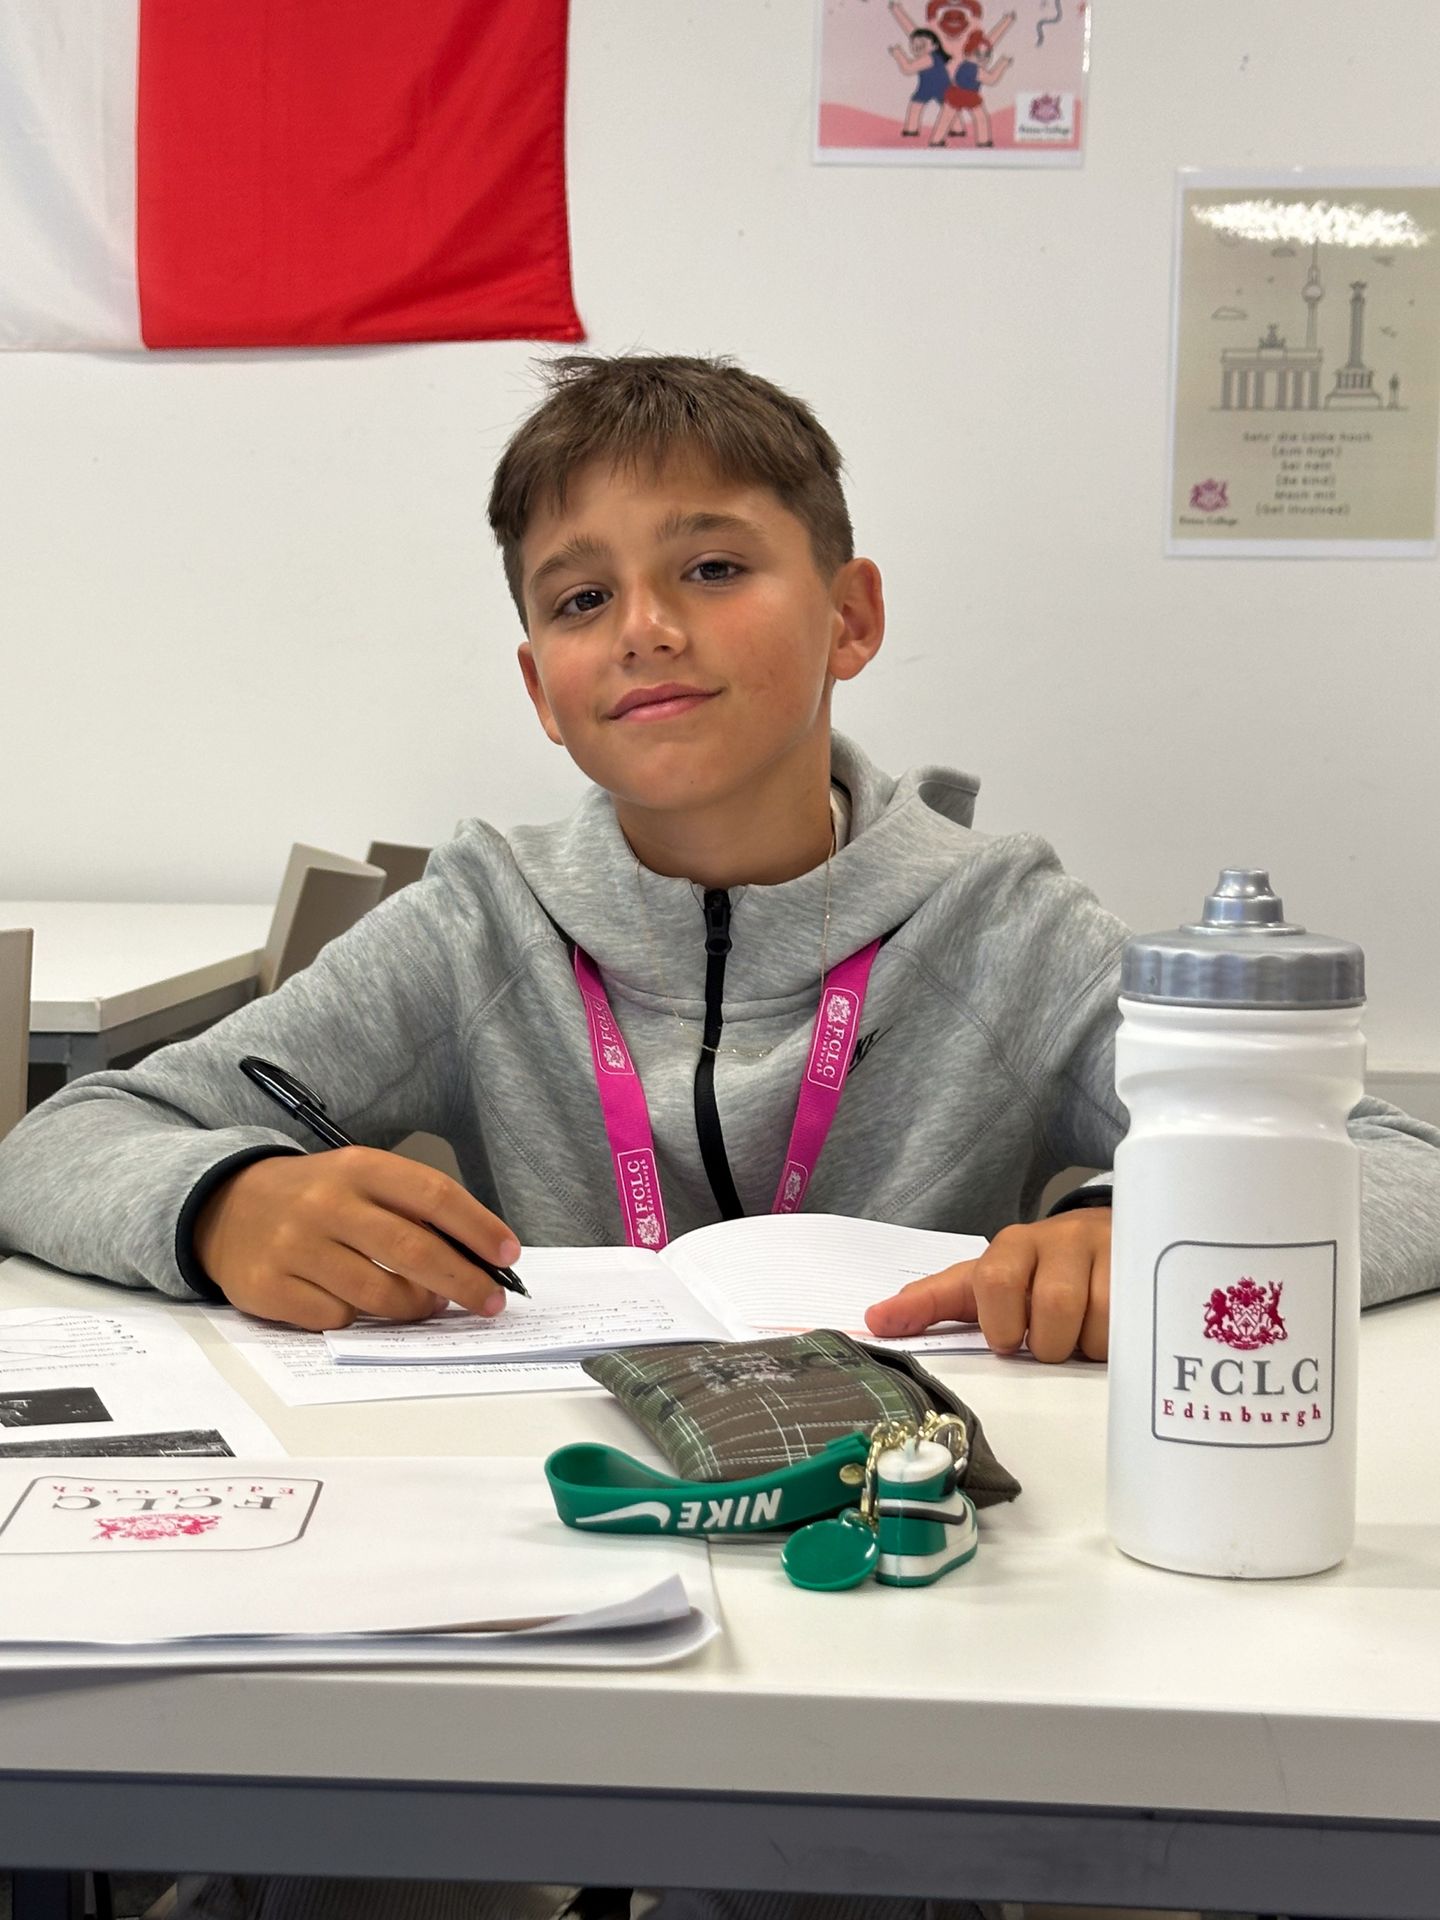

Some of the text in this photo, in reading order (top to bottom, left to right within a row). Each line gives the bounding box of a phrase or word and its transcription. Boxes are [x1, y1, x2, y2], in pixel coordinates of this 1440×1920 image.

[823, 1027, 845, 1079] FCLC
[627, 1160, 648, 1214] FCLC
[1172, 1354, 1319, 1396] FCLC
[1162, 1398, 1322, 1427] Edinburgh
[51, 1494, 281, 1512] FCLC
[677, 1487, 784, 1531] NIKE
